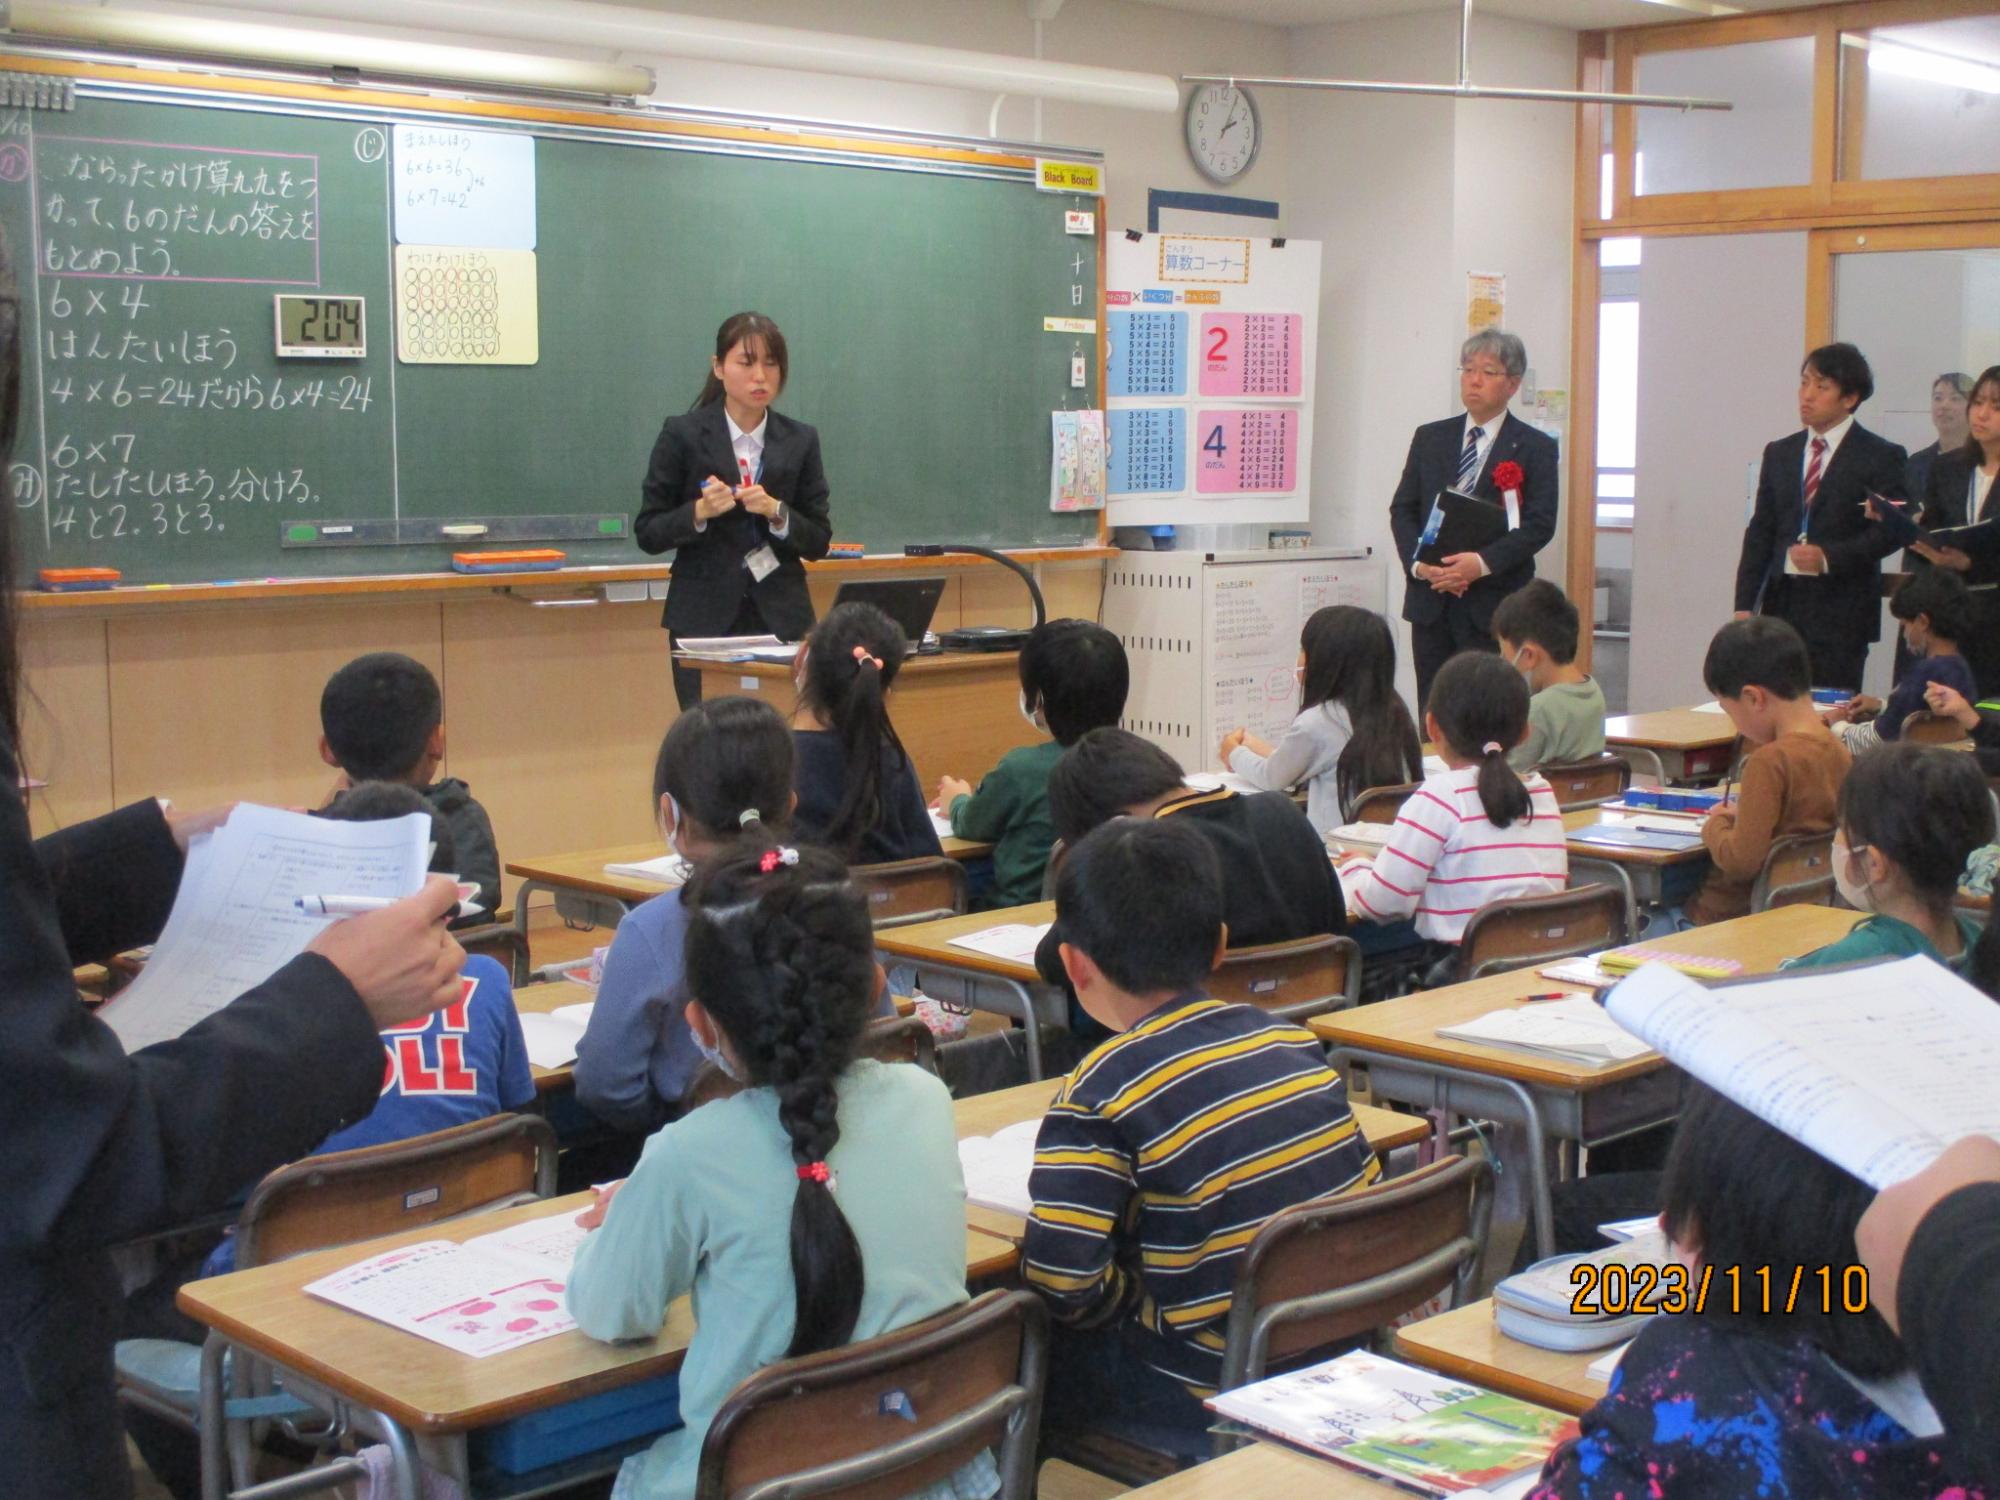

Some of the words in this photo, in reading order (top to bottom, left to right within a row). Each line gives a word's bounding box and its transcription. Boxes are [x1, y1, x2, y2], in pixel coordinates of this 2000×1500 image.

[1044, 171, 1065, 183] Black
[1070, 174, 1093, 186] Board
[1166, 254, 1245, 271] 算数コーナー
[1207, 326, 1228, 361] 2
[1203, 425, 1226, 458] 4
